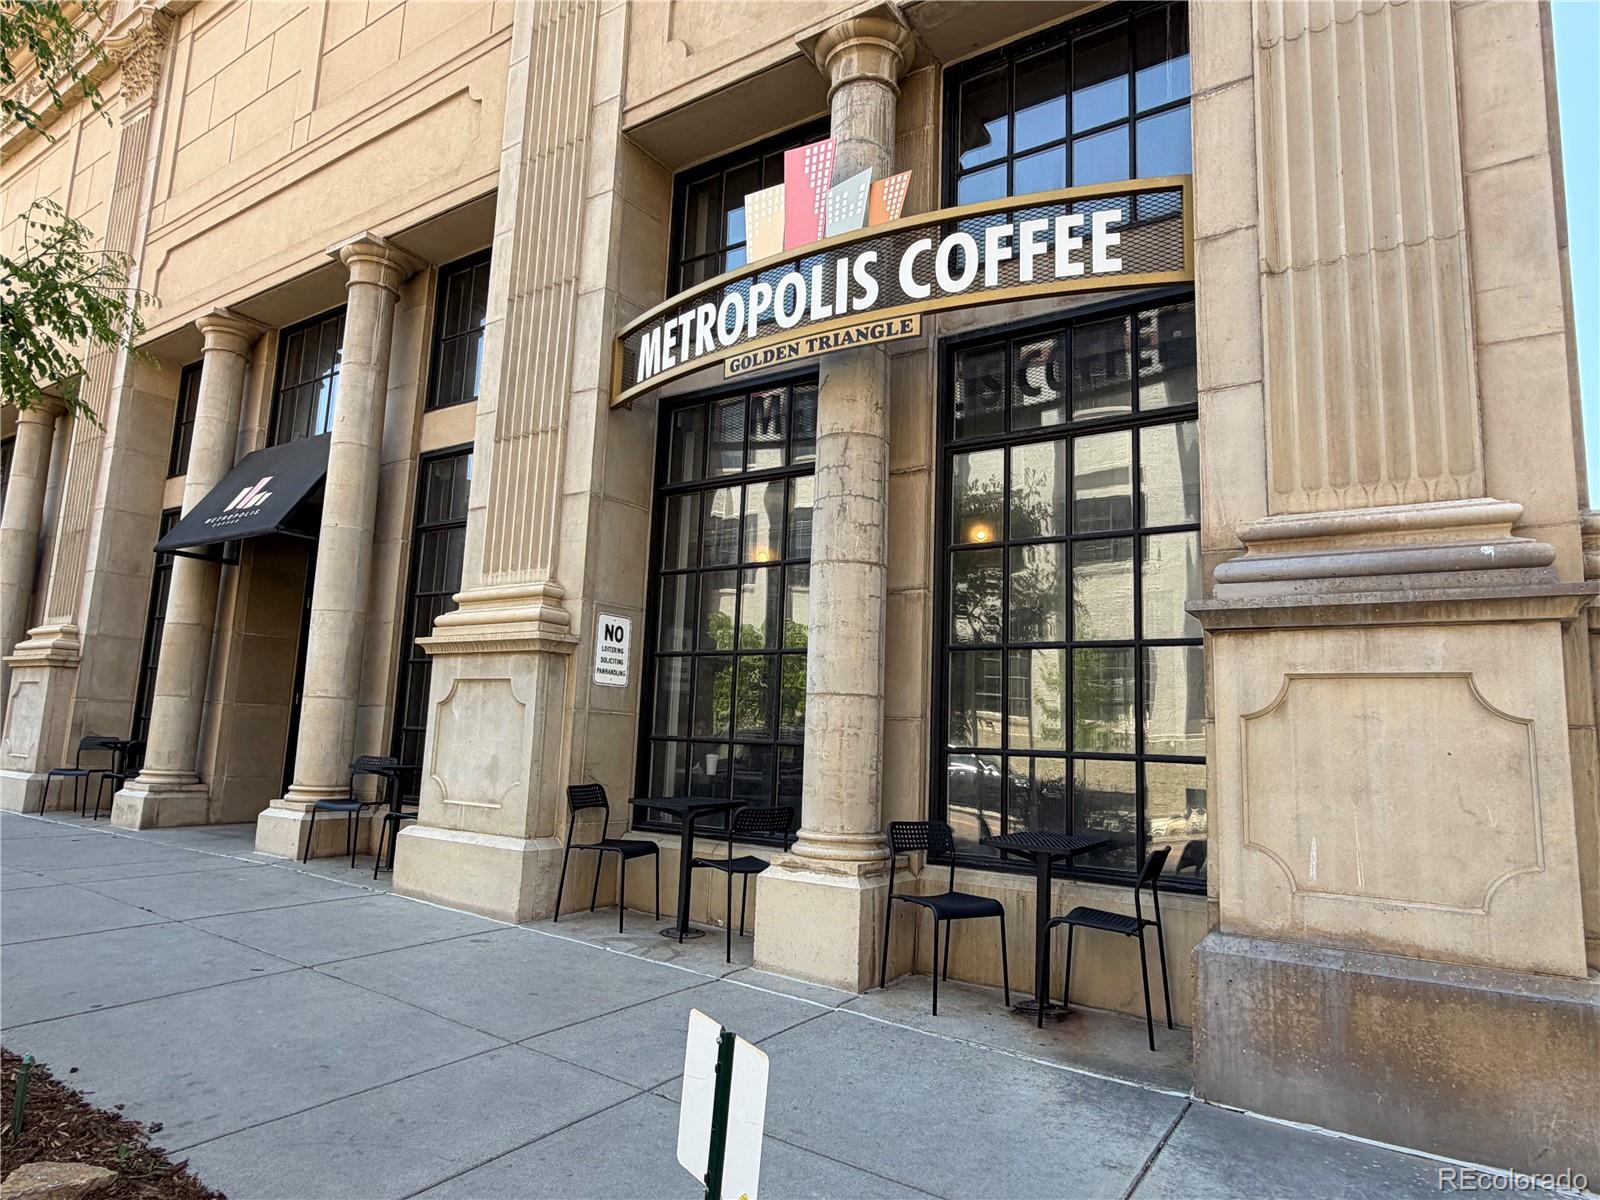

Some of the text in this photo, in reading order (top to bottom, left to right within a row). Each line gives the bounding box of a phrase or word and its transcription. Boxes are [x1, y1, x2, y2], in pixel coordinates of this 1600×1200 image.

[636, 250, 880, 384] METROPOLIS
[898, 209, 1123, 299] COFFEE
[729, 318, 914, 374] GOLDEN TRIANGLE
[604, 623, 624, 643] NO
[601, 645, 624, 654] LOITERING
[600, 656, 624, 666] SOLICITING
